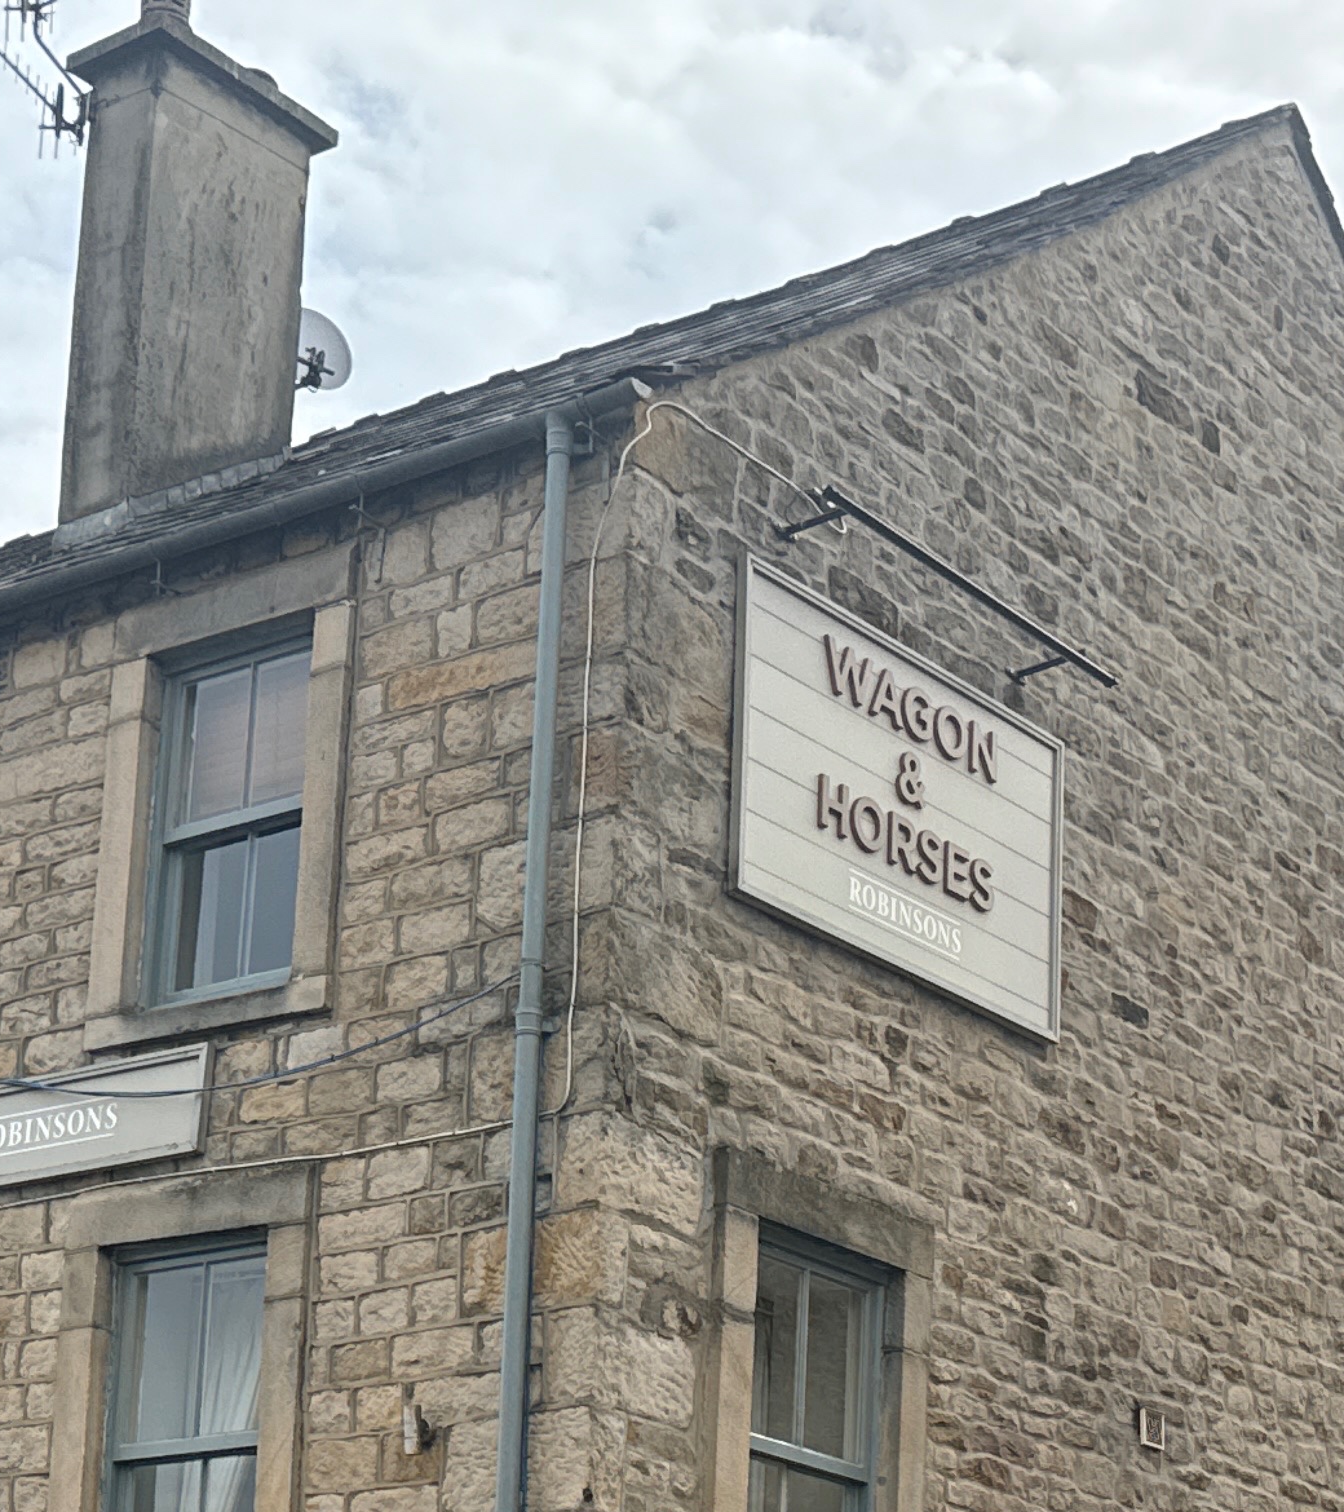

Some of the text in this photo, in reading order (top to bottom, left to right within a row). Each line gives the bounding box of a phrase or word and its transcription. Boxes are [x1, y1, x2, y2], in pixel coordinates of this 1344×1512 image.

[823, 633, 998, 784] WAGON
[896, 751, 925, 810] &
[816, 772, 995, 912] HORSES
[849, 876, 962, 954] ROBINSONS
